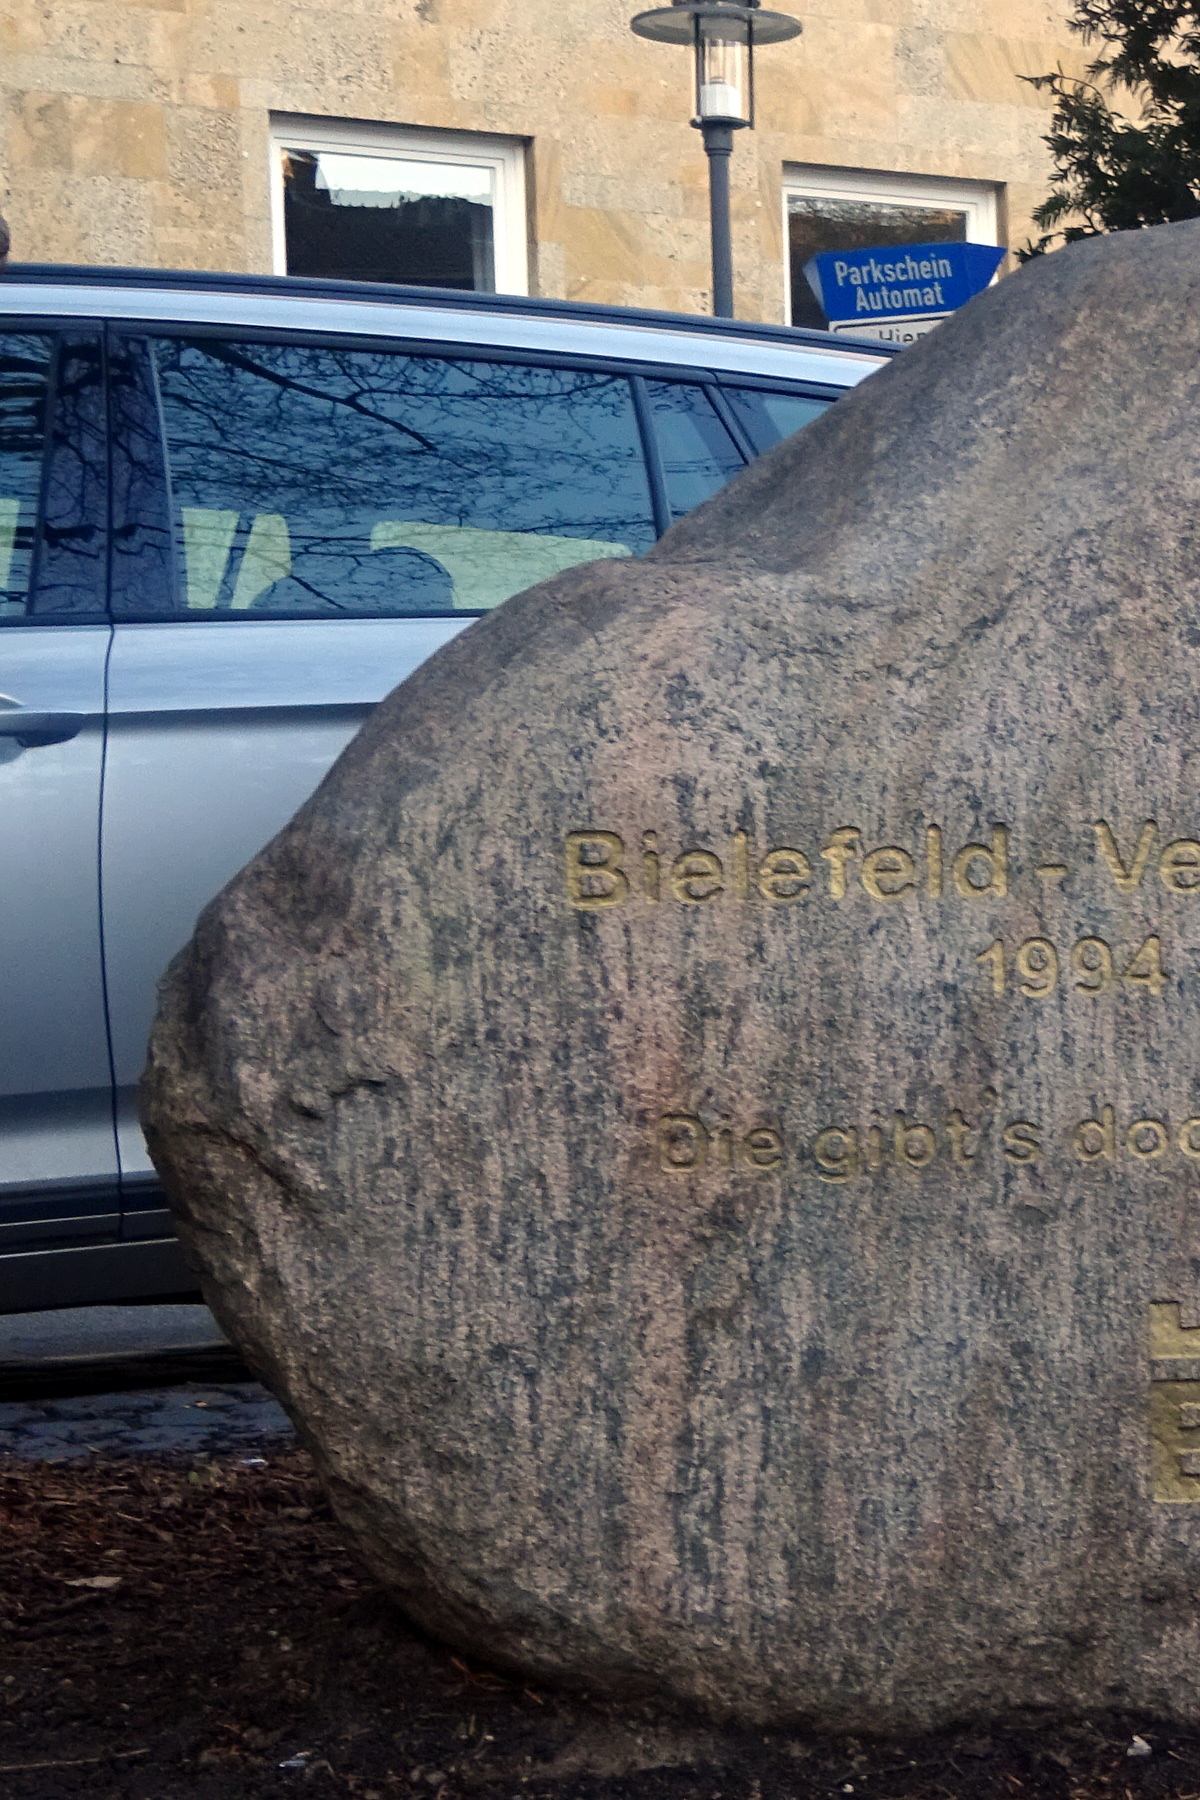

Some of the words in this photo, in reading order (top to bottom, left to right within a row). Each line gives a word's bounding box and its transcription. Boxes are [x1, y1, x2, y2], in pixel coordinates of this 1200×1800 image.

[834, 253, 952, 286] Parkschein
[856, 282, 945, 312] Automat
[565, 822, 1009, 908] Bielefeld
[977, 935, 1169, 997] 1994
[659, 1112, 784, 1173] Die
